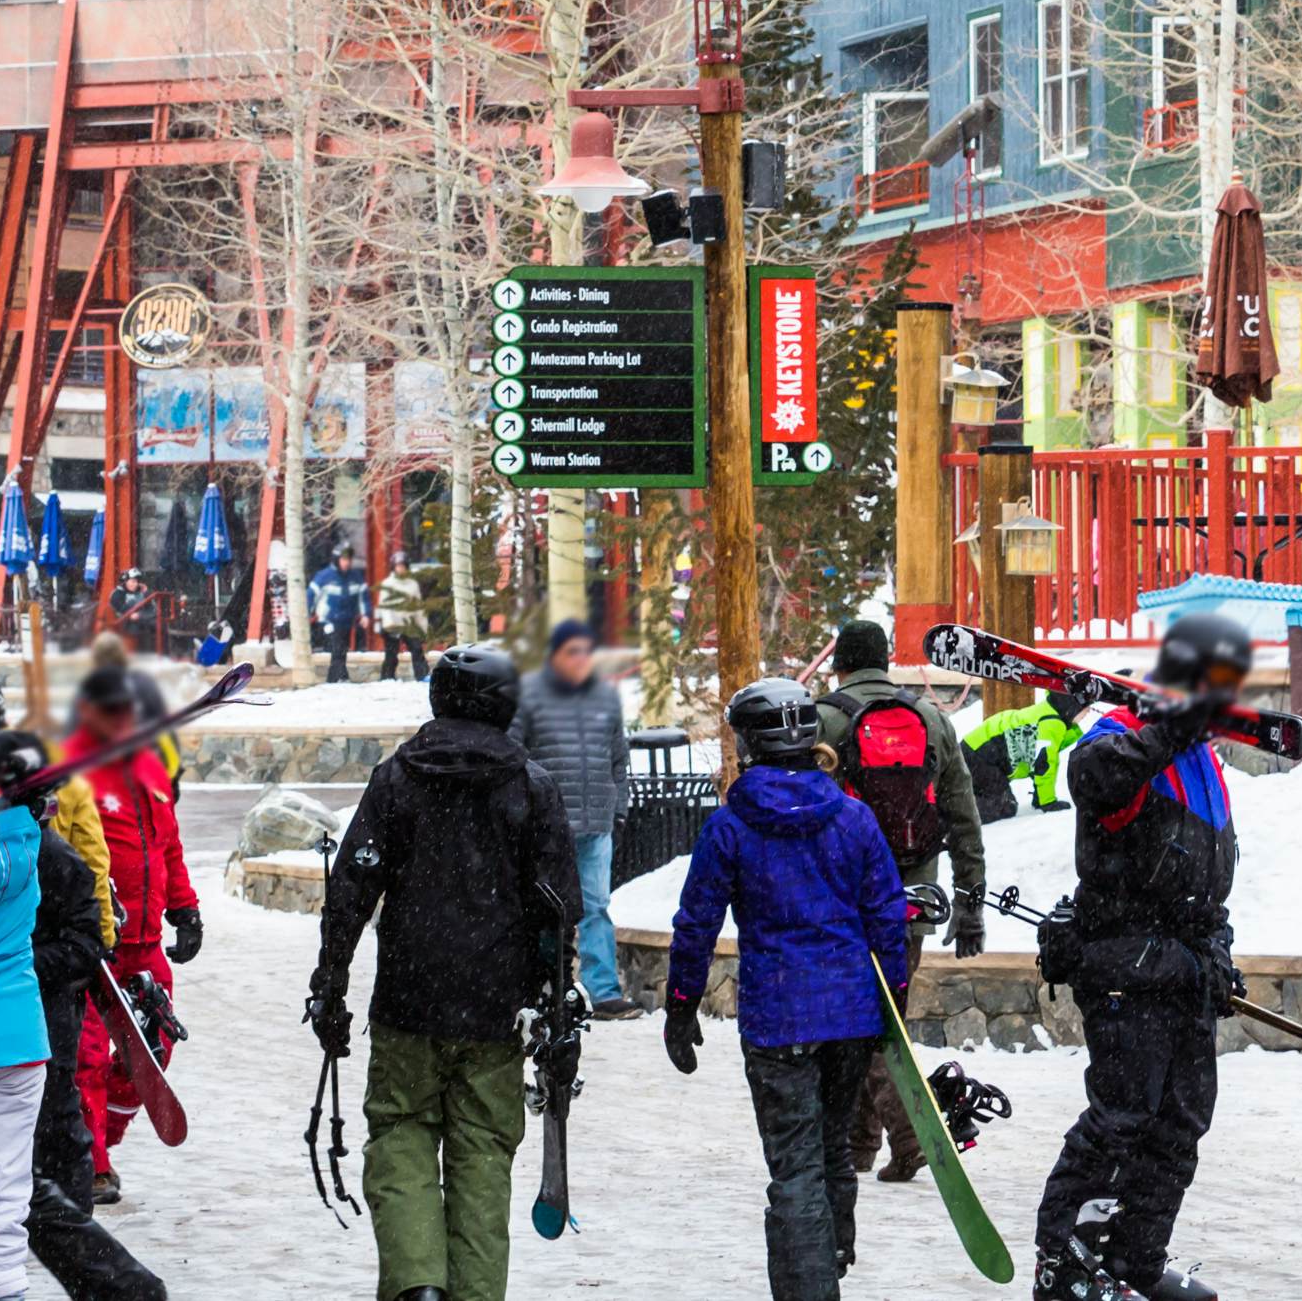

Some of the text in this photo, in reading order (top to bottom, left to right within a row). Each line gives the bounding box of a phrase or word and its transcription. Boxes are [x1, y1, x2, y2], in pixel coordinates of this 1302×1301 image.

[530, 287, 572, 302] Activities
[578, 287, 610, 304] Dining
[530, 320, 618, 337] Condo Registration
[775, 290, 802, 396] KEYSTONE
[530, 352, 641, 370] Montezuma Parking Lot
[530, 385, 599, 403] Transportation
[530, 418, 605, 435] Silvermill Lodge
[530, 452, 601, 466] Warren Station
[772, 442, 789, 472] P
